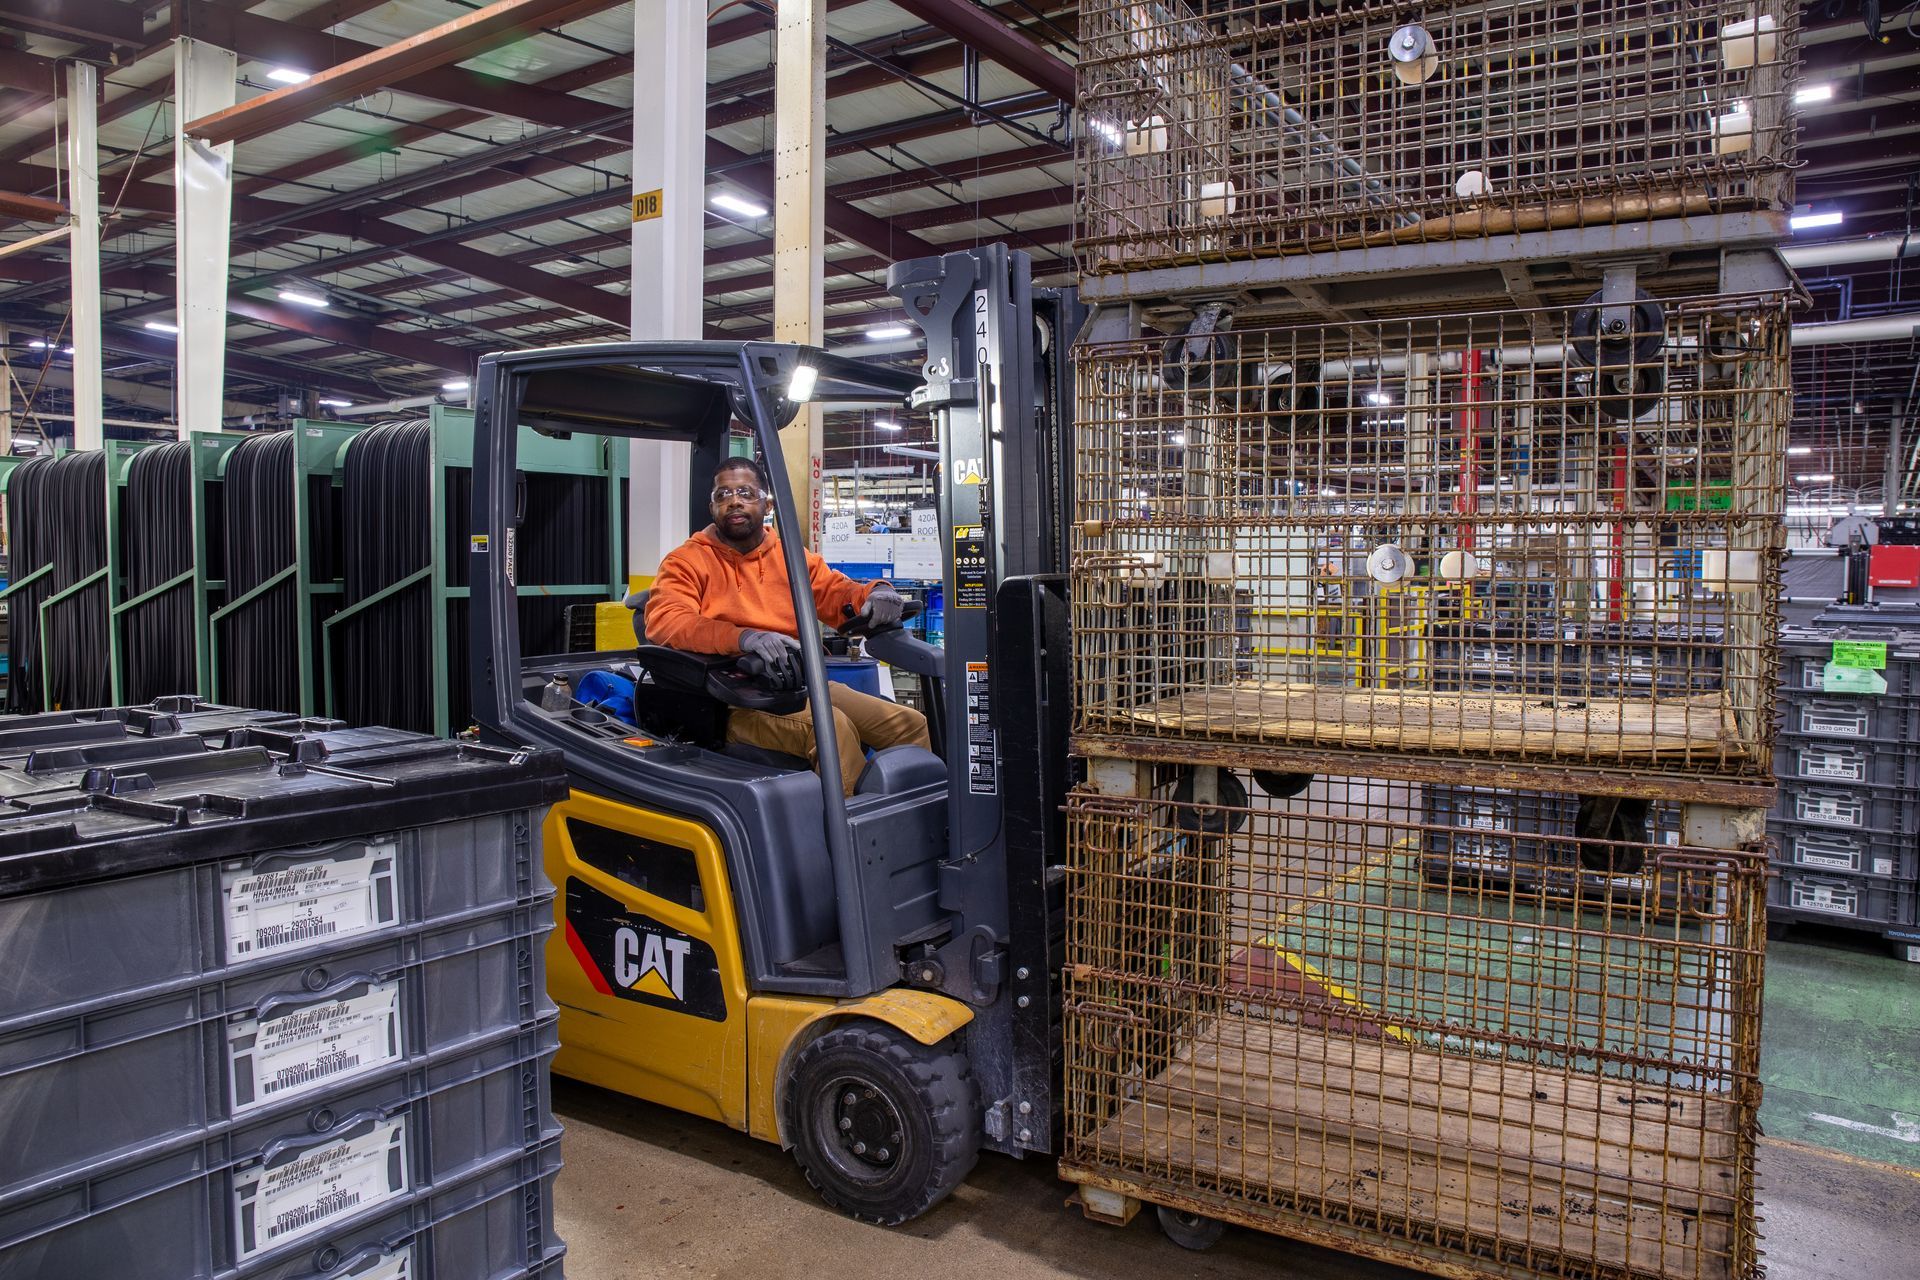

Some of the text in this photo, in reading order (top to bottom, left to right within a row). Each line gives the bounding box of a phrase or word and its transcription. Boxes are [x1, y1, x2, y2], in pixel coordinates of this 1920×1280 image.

[812, 458, 820, 479] NO
[953, 458, 983, 485] CAT
[917, 513, 936, 523] 420A
[831, 522, 849, 530] 420A
[831, 533, 849, 542] ROOF
[252, 884, 296, 899] HHA4/MHA4
[307, 907, 313, 916] 5
[614, 927, 691, 1002] CAT
[278, 1022, 320, 1041] HHA4/MHA4
[331, 1043, 337, 1052] 5
[278, 1165, 321, 1187] HHA4/MHA4
[332, 1183, 337, 1192] 5
